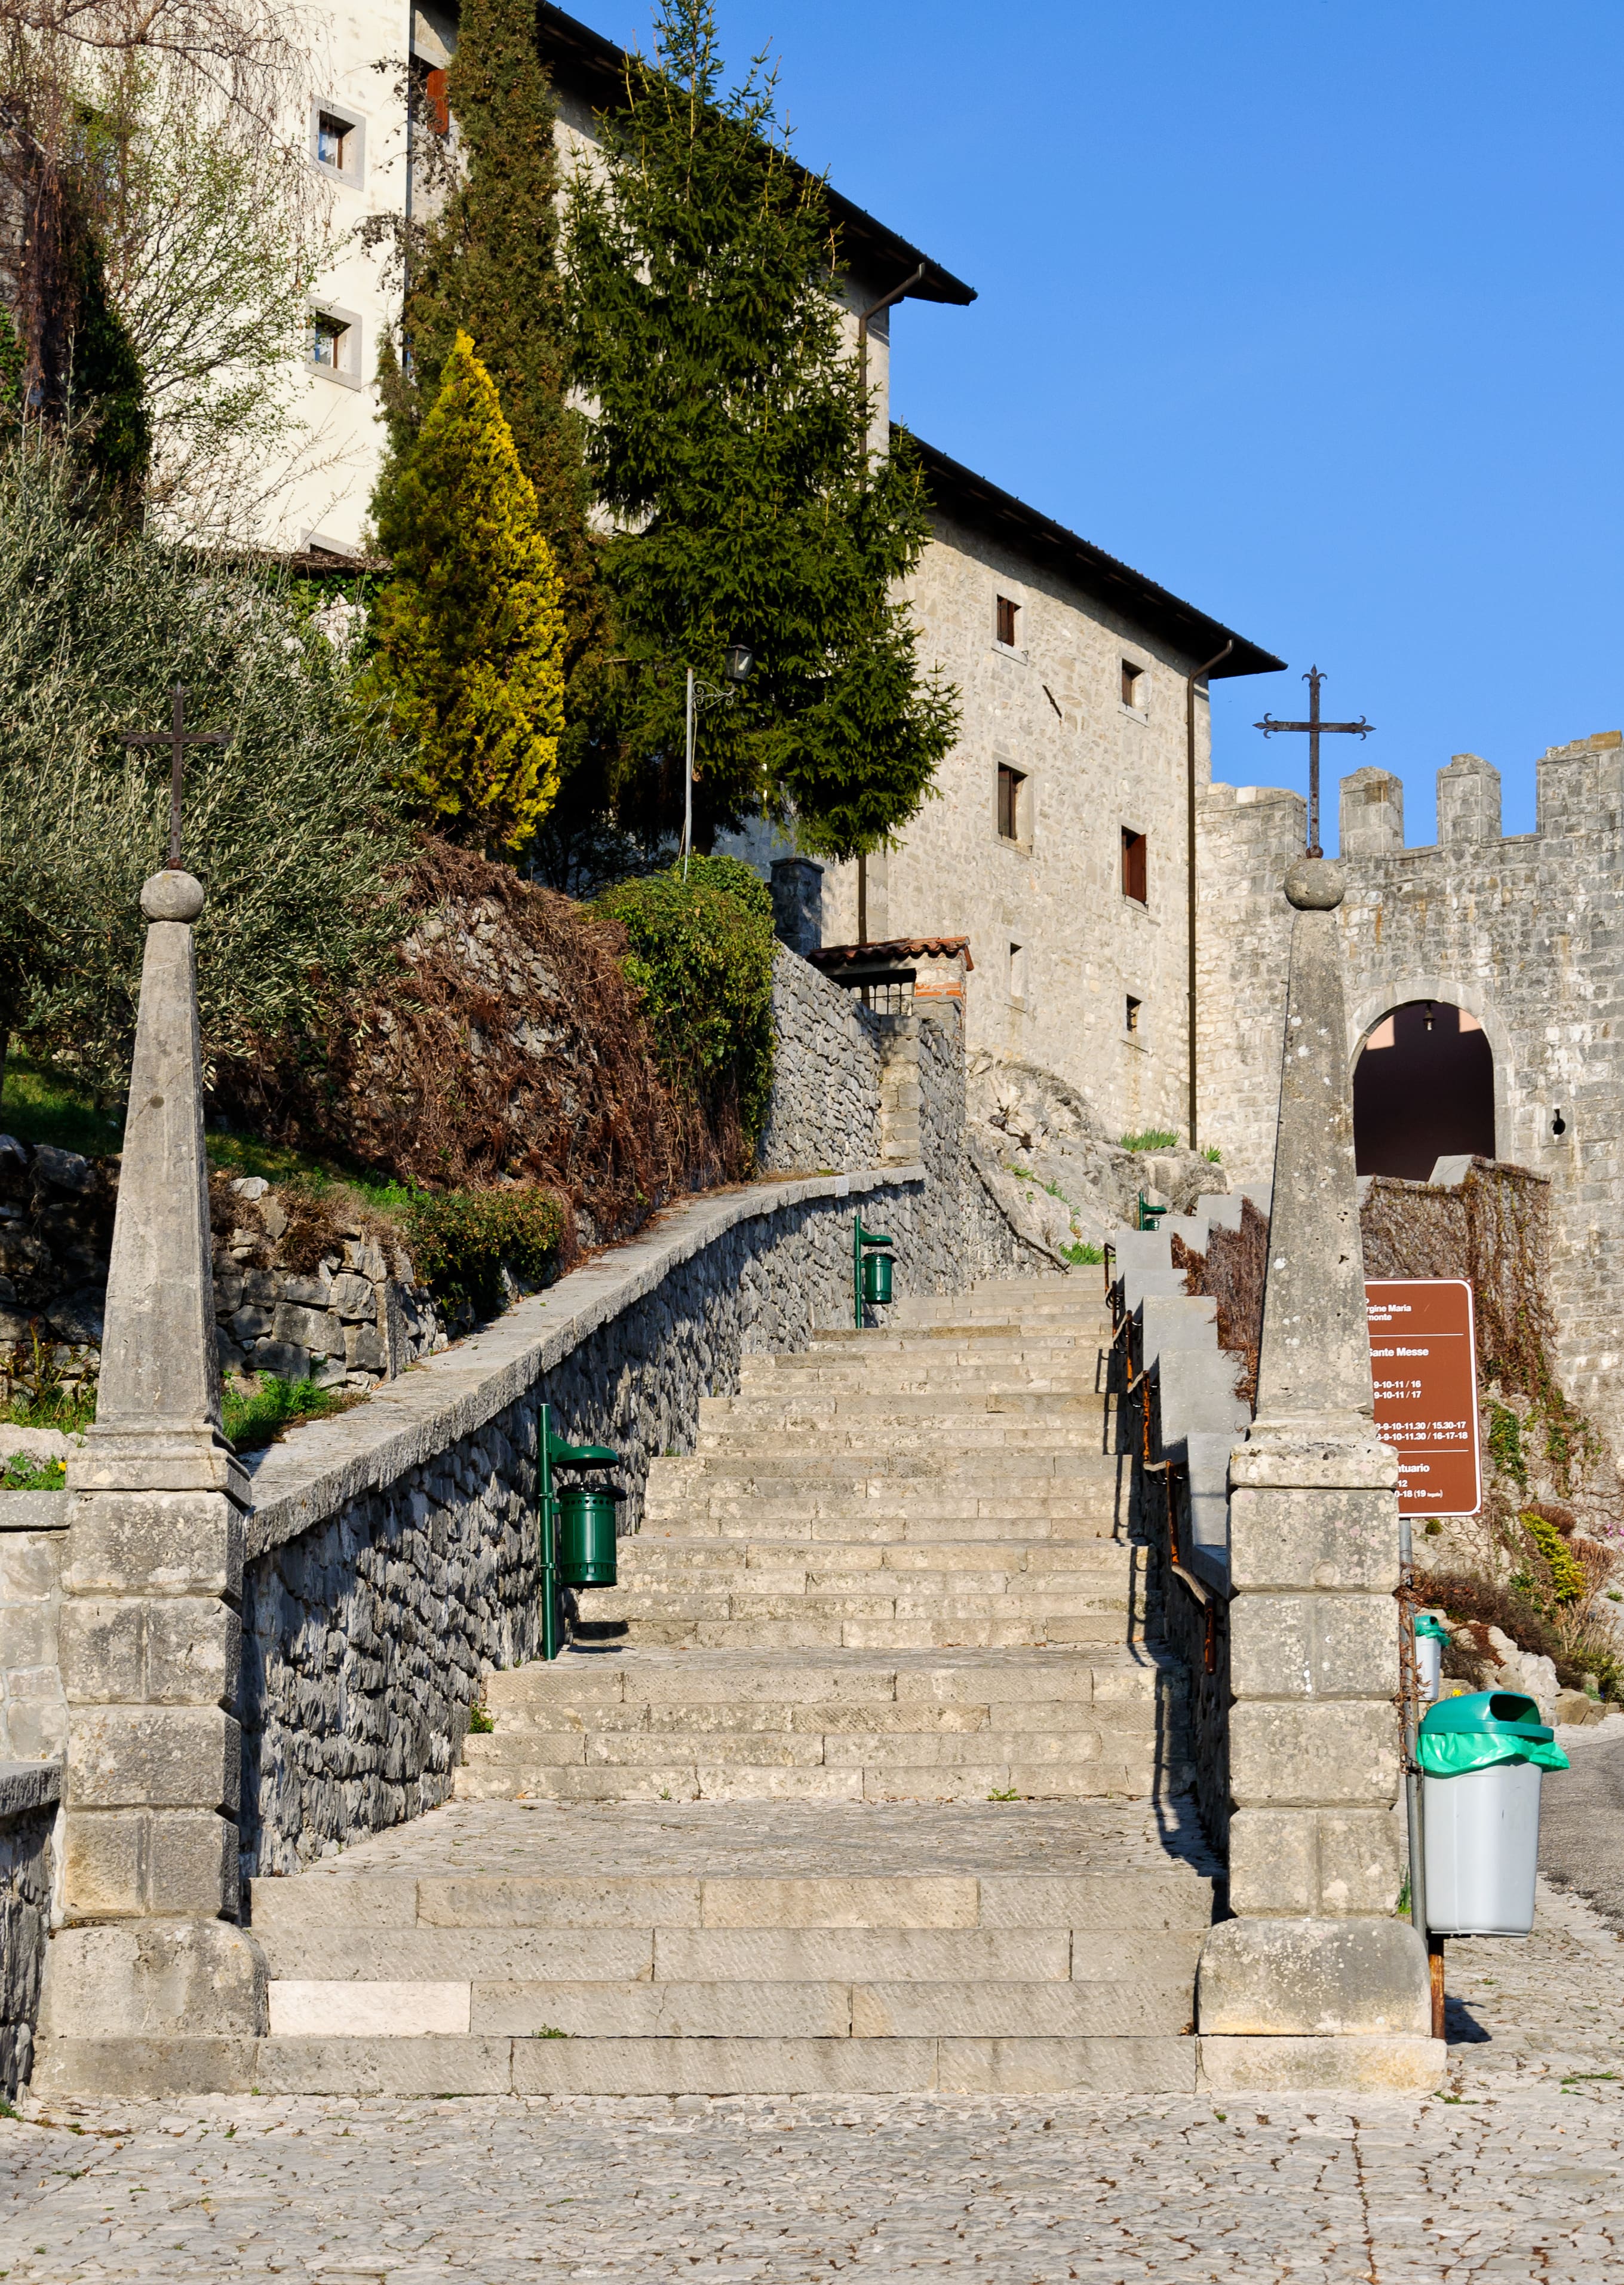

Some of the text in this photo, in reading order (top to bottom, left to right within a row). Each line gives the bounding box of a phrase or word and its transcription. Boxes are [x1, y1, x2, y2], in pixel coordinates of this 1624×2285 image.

[1369, 1347, 1429, 1357] Sante Messe
[1374, 1391, 1404, 1399] 9-10-11
